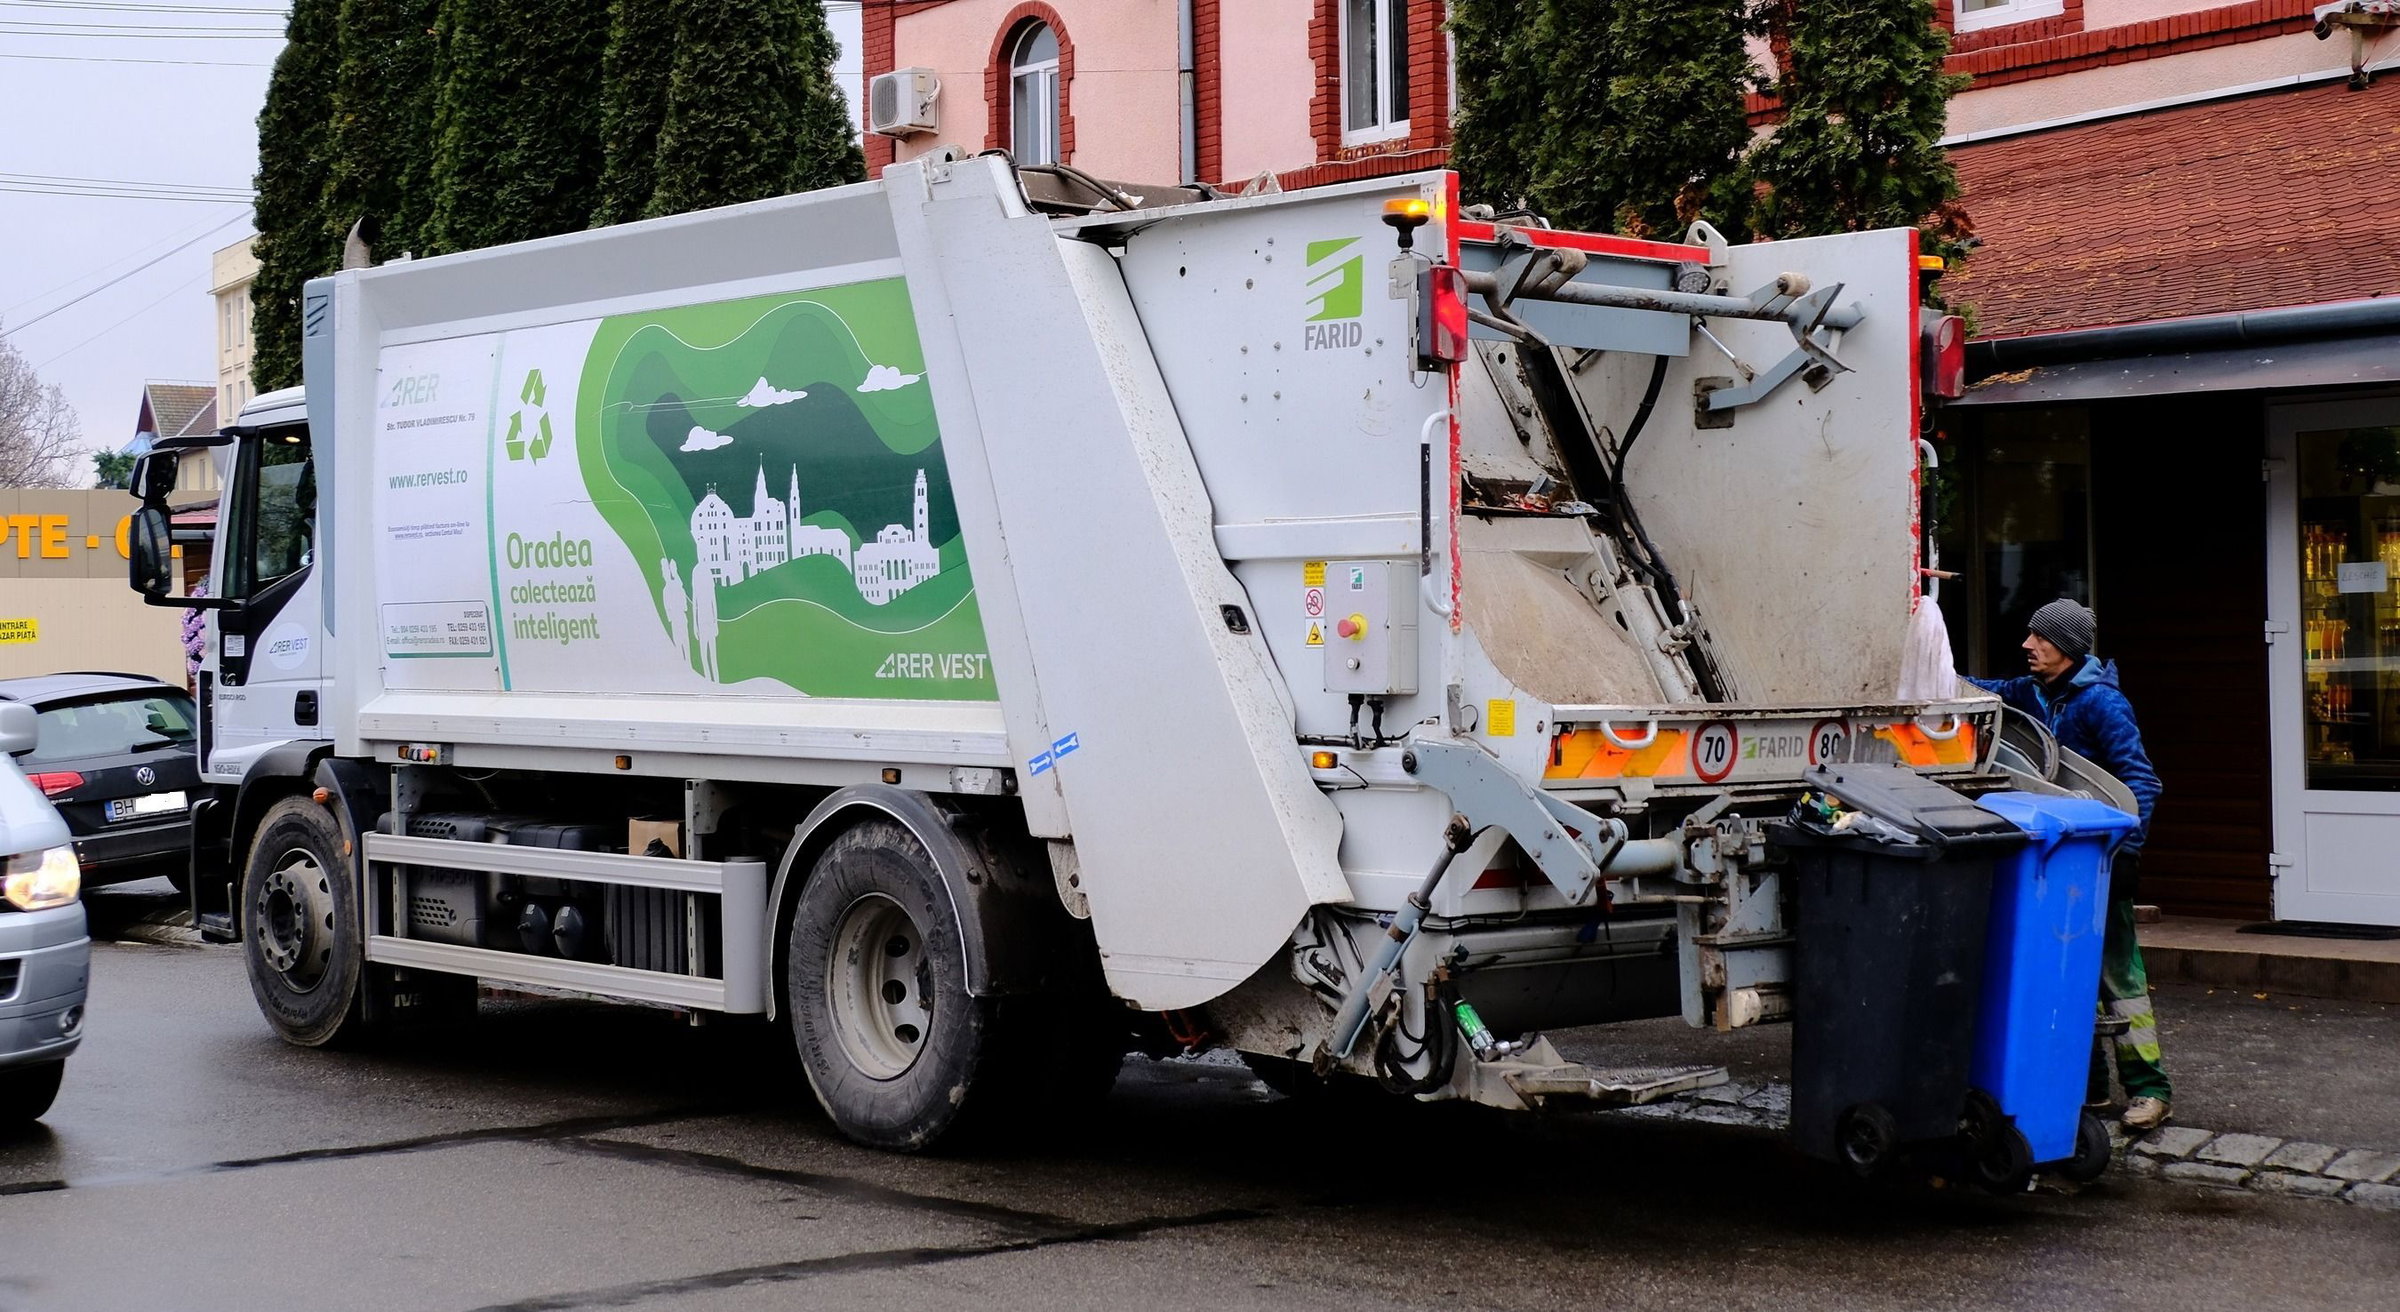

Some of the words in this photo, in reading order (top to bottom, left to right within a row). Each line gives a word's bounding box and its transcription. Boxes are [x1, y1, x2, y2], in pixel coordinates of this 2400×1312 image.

[1305, 322, 1362, 351] FARID
[388, 467, 468, 490] www.rervest.ro
[506, 531, 593, 569] Oradea
[510, 575, 596, 604] colectează
[513, 612, 600, 646] inteligent
[292, 637, 308, 650] VEST
[938, 653, 987, 679] VEST
[1705, 736, 1725, 763] 70
[1758, 736, 1804, 759] FARID
